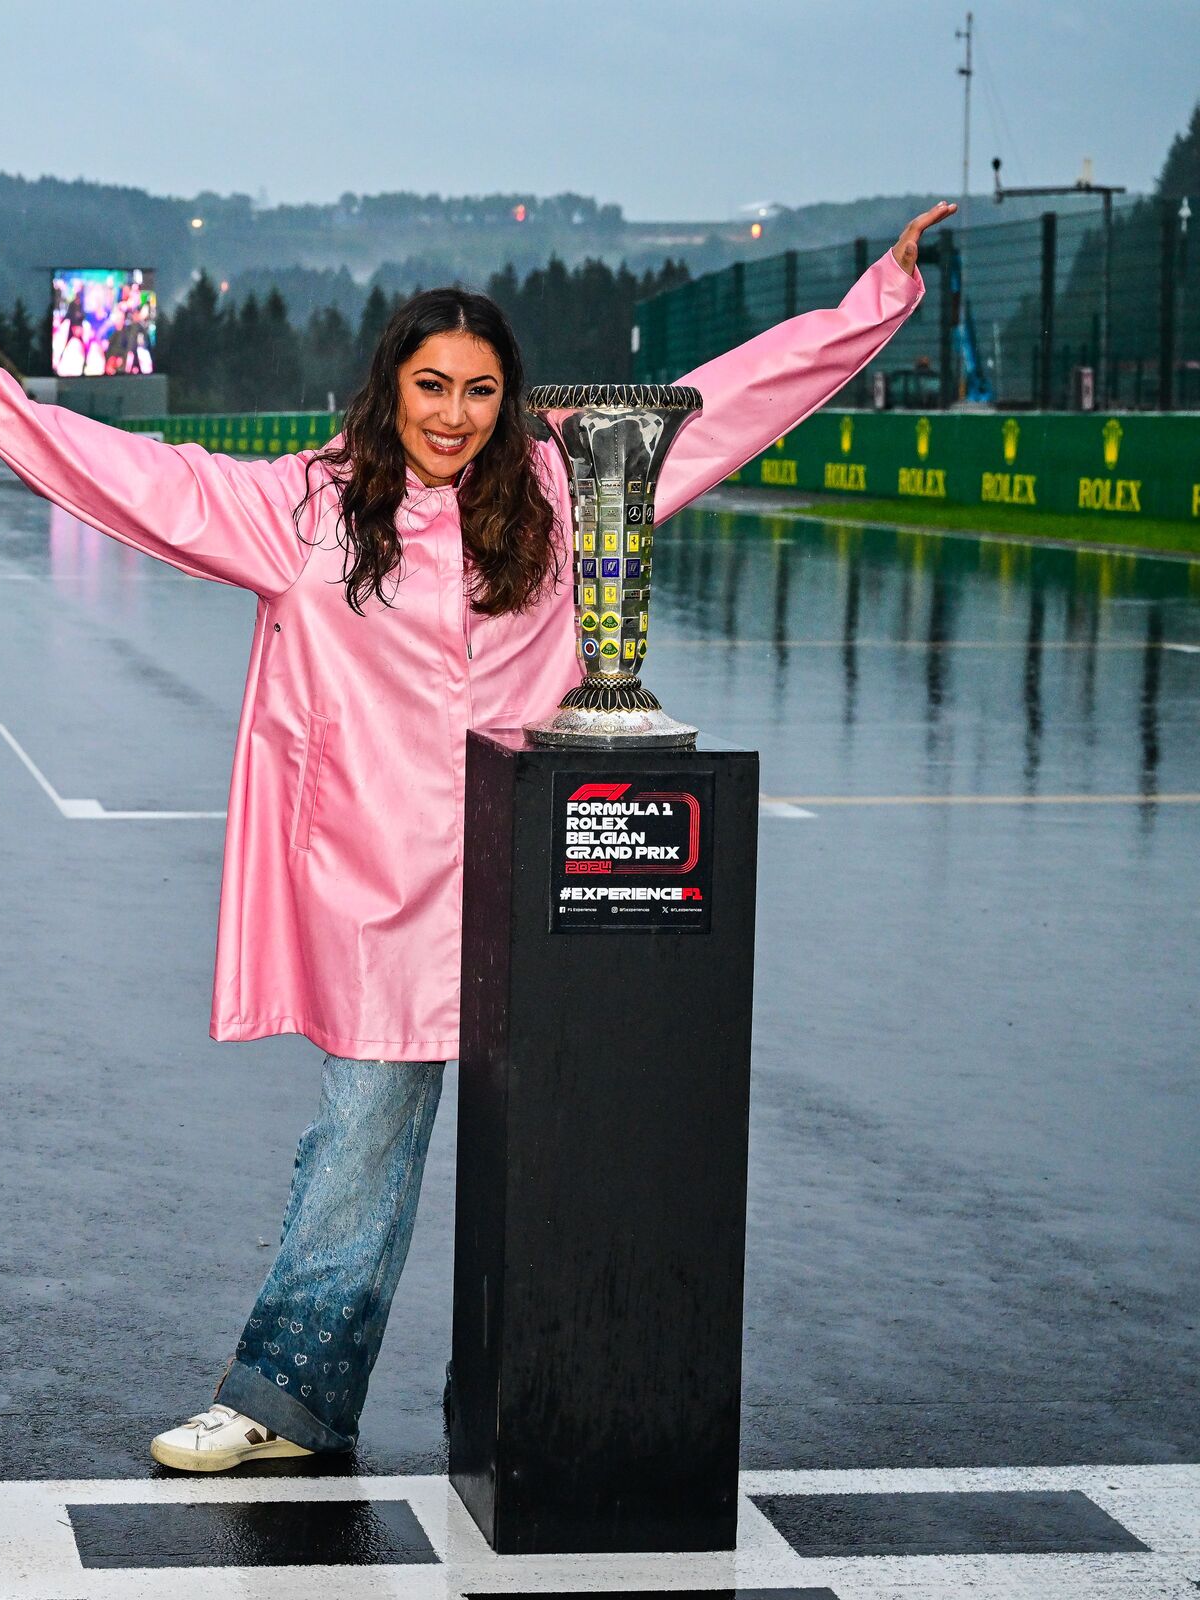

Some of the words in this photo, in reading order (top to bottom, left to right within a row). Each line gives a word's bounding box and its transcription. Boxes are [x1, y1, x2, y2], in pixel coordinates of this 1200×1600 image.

[824, 462, 867, 491] ROLEX
[898, 466, 946, 498] ROLEX
[981, 472, 1037, 505] ROLEX
[1078, 477, 1142, 512] ROLEX
[566, 803, 659, 816] FORMULA
[663, 803, 673, 816] 1
[566, 817, 628, 830] ROLEX
[566, 832, 645, 845] BELGIAN
[566, 847, 632, 859] GRAND
[635, 847, 680, 859] PRIX
[565, 861, 612, 874] 2024
[560, 887, 703, 900] #EXPERIENCEF1
